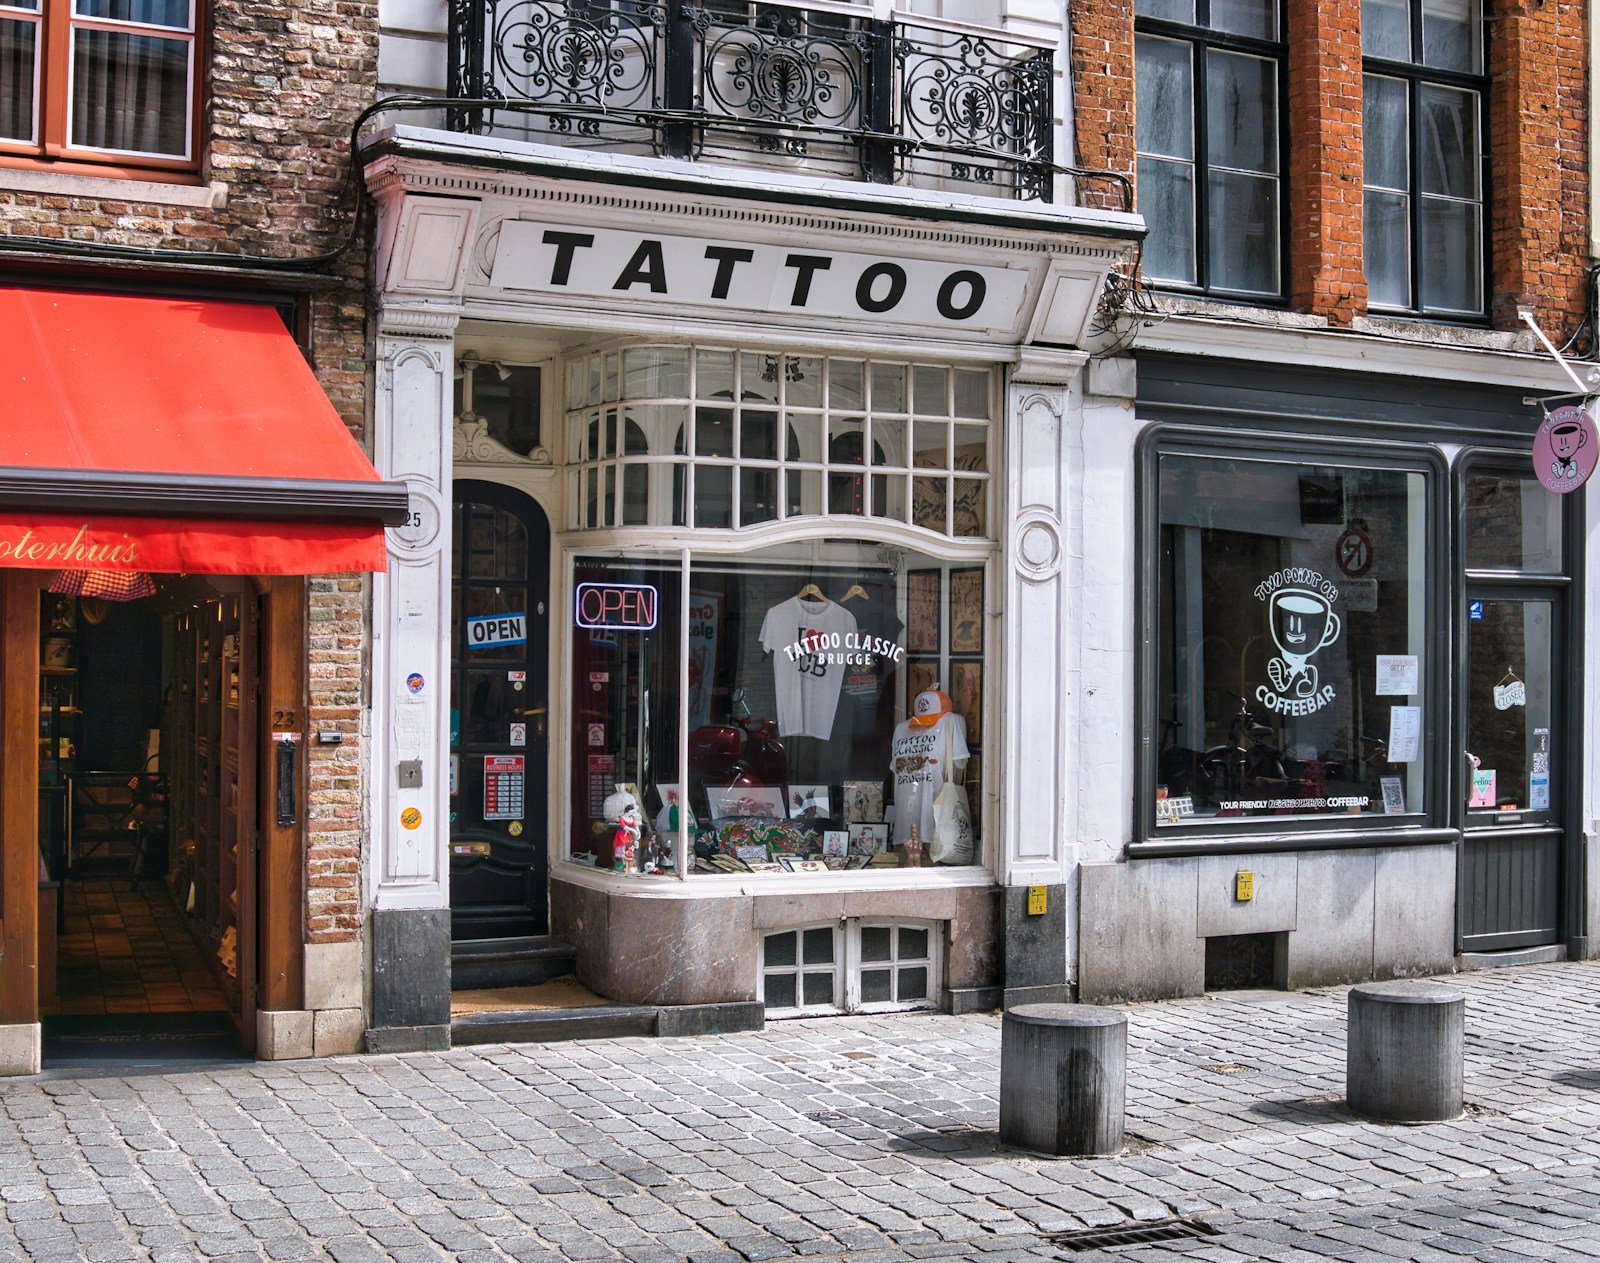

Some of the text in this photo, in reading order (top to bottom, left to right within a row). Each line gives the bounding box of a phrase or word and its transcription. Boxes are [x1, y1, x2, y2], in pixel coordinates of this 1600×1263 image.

[541, 230, 987, 320] TATTOO
[1546, 468, 1588, 490] COFFEEBAR
[1254, 571, 1283, 601] TWO
[1320, 580, 1339, 602] OH
[581, 588, 653, 625] OPEN
[473, 618, 522, 642] OPEN
[783, 632, 905, 663] TATTOO CLASSIC
[818, 652, 871, 665] BRUGGE
[1255, 684, 1336, 717] COFFEEBAR
[1497, 689, 1524, 707] CLOSED
[273, 711, 295, 728] 23
[894, 743, 934, 756] CLASSIC
[896, 734, 936, 746] TATTOO
[1220, 801, 1239, 810] YOUR
[1239, 799, 1268, 809] FRIENDLY
[1326, 795, 1369, 808] COFFEEBAR
